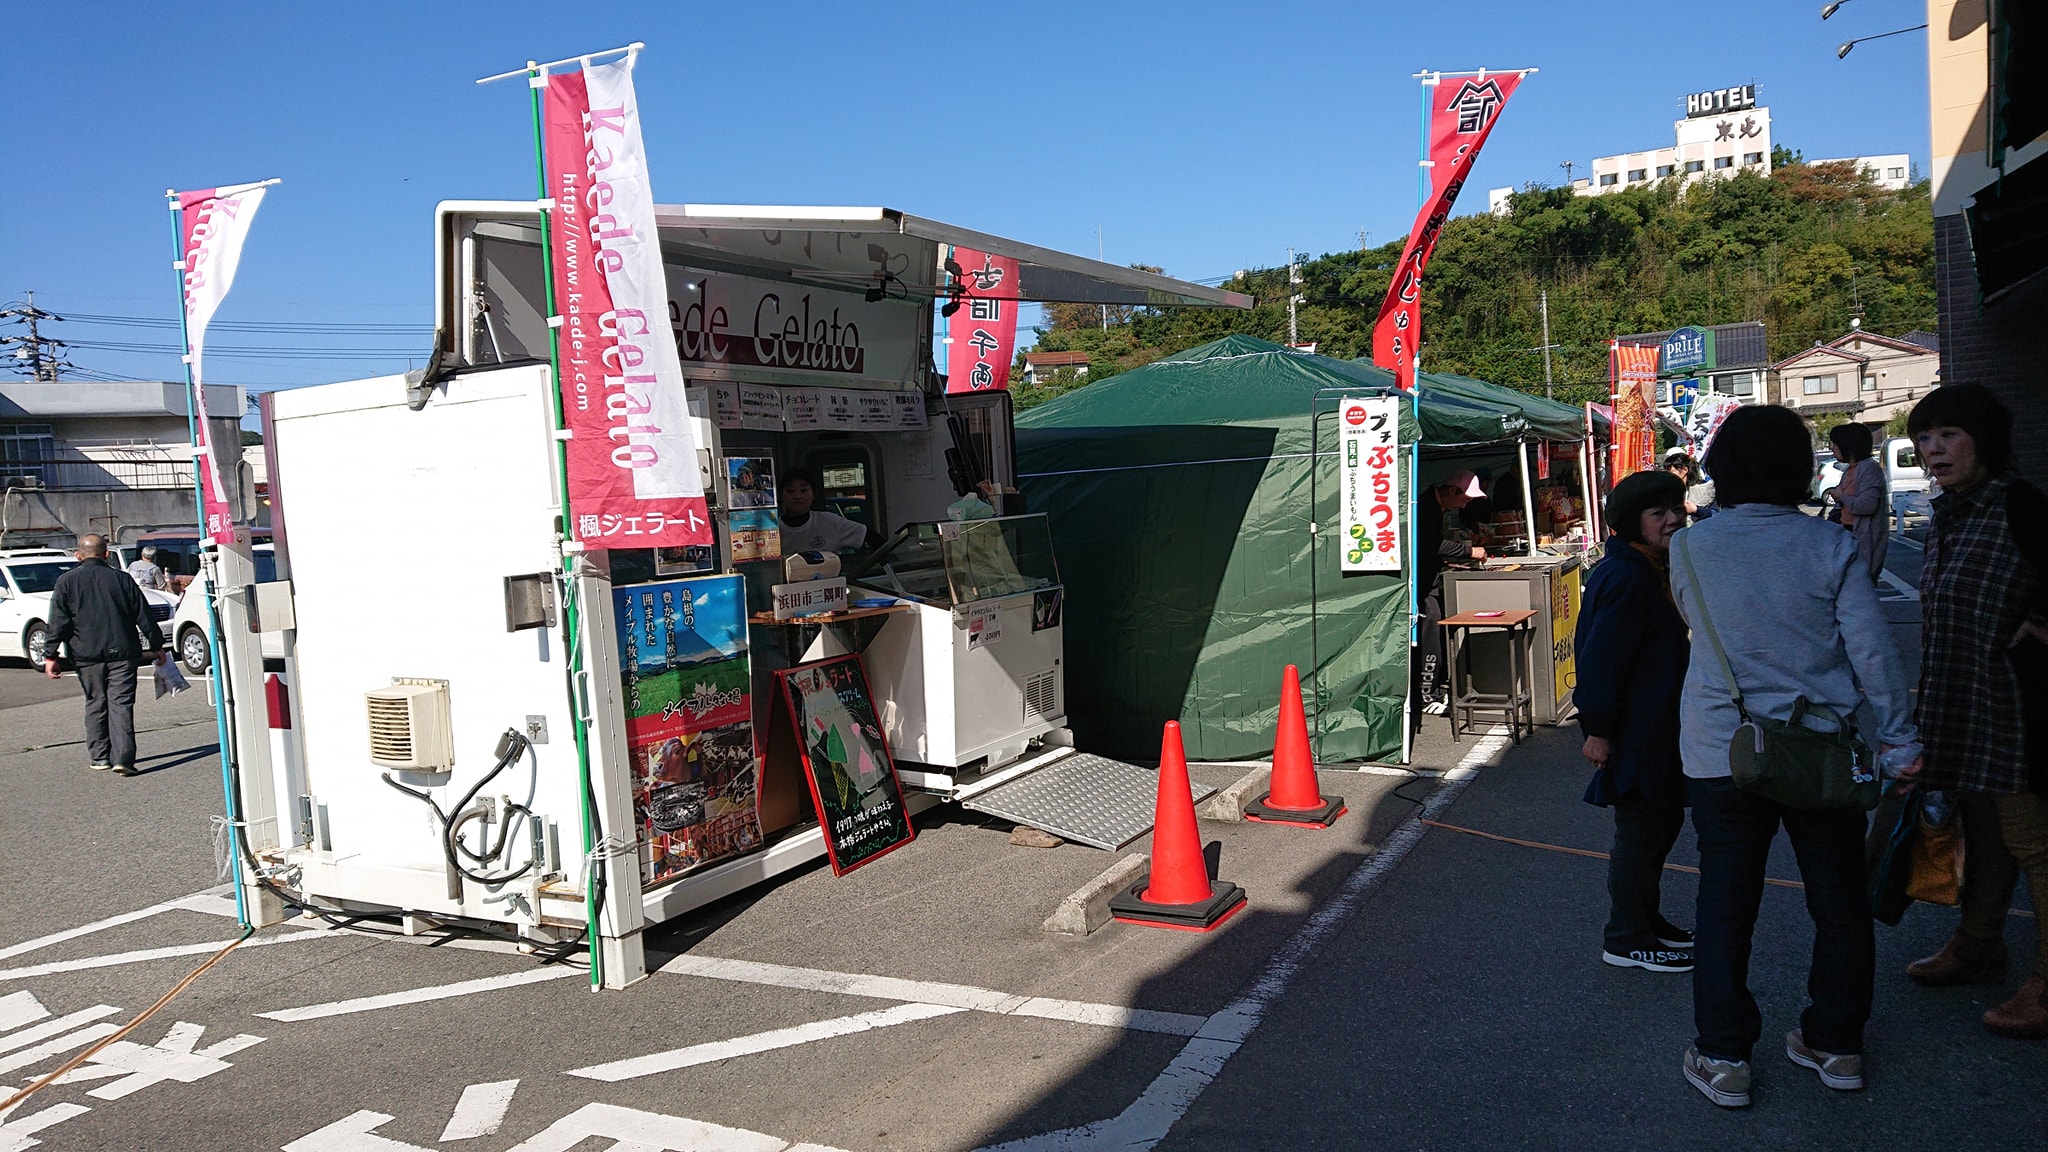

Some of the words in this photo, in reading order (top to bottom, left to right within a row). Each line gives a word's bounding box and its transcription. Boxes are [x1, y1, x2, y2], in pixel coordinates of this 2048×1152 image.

[1687, 86, 1755, 114] HOTEL
[1714, 115, 1763, 143] 東光
[580, 101, 633, 275] Kaede
[562, 173, 590, 411] http://www.kaede-j.com
[753, 292, 861, 371] Gelato
[1666, 336, 1703, 360] PRILE
[598, 307, 662, 469] Gelato
[785, 394, 820, 405] チョコレート
[1675, 384, 1685, 403] P
[578, 509, 706, 538] 楓ジェラート
[778, 586, 846, 610] 浜田市三隅町
[642, 593, 657, 647] 囲まれた
[662, 590, 677, 669] 豊かな自然に
[624, 595, 641, 710] メイプル牧場からの
[1420, 653, 1438, 703] adidas
[662, 687, 742, 721] メイプル牧場
